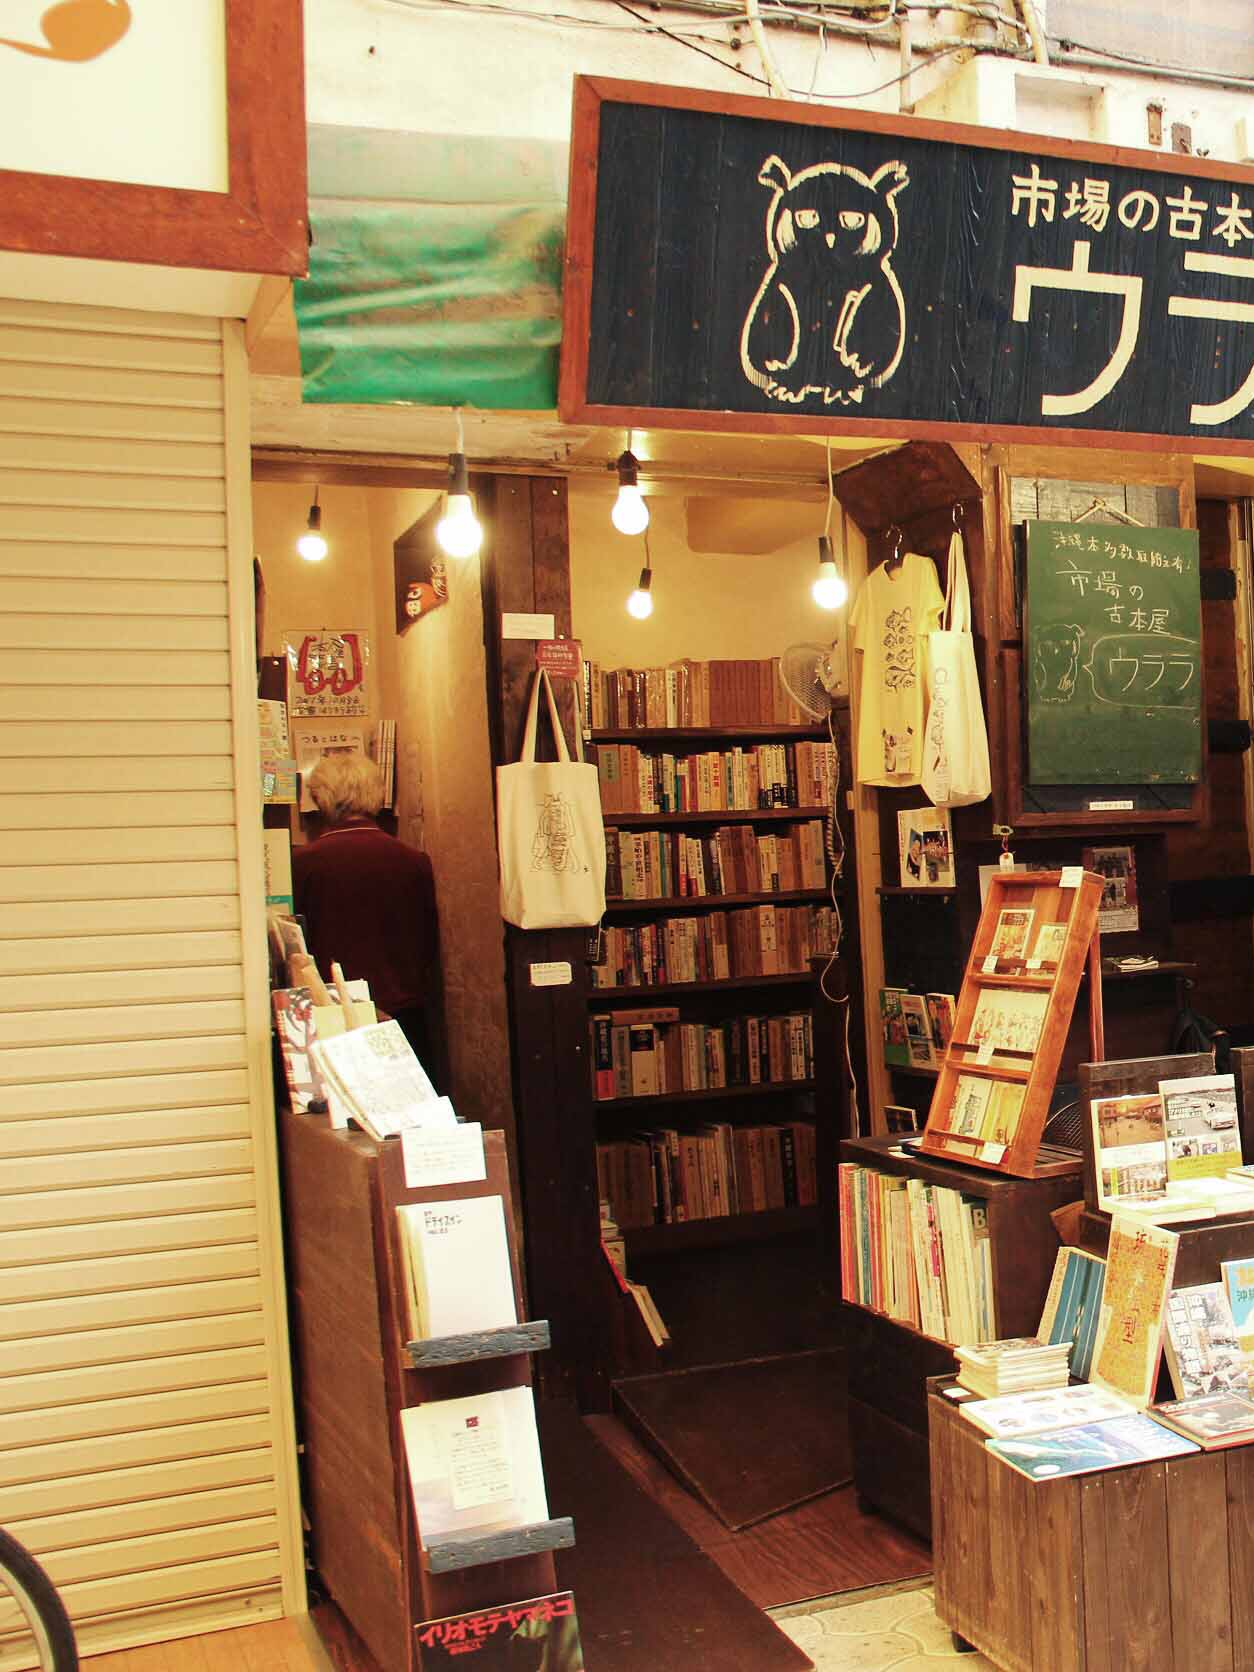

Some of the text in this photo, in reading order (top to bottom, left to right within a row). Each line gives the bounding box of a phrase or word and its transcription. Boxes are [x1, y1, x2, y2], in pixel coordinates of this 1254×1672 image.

[1056, 560, 1144, 600] 市場の
[1104, 603, 1171, 635] 古本屋
[1109, 647, 1194, 691] ウララ
[420, 1598, 574, 1648] イリオモテヤマネコ
